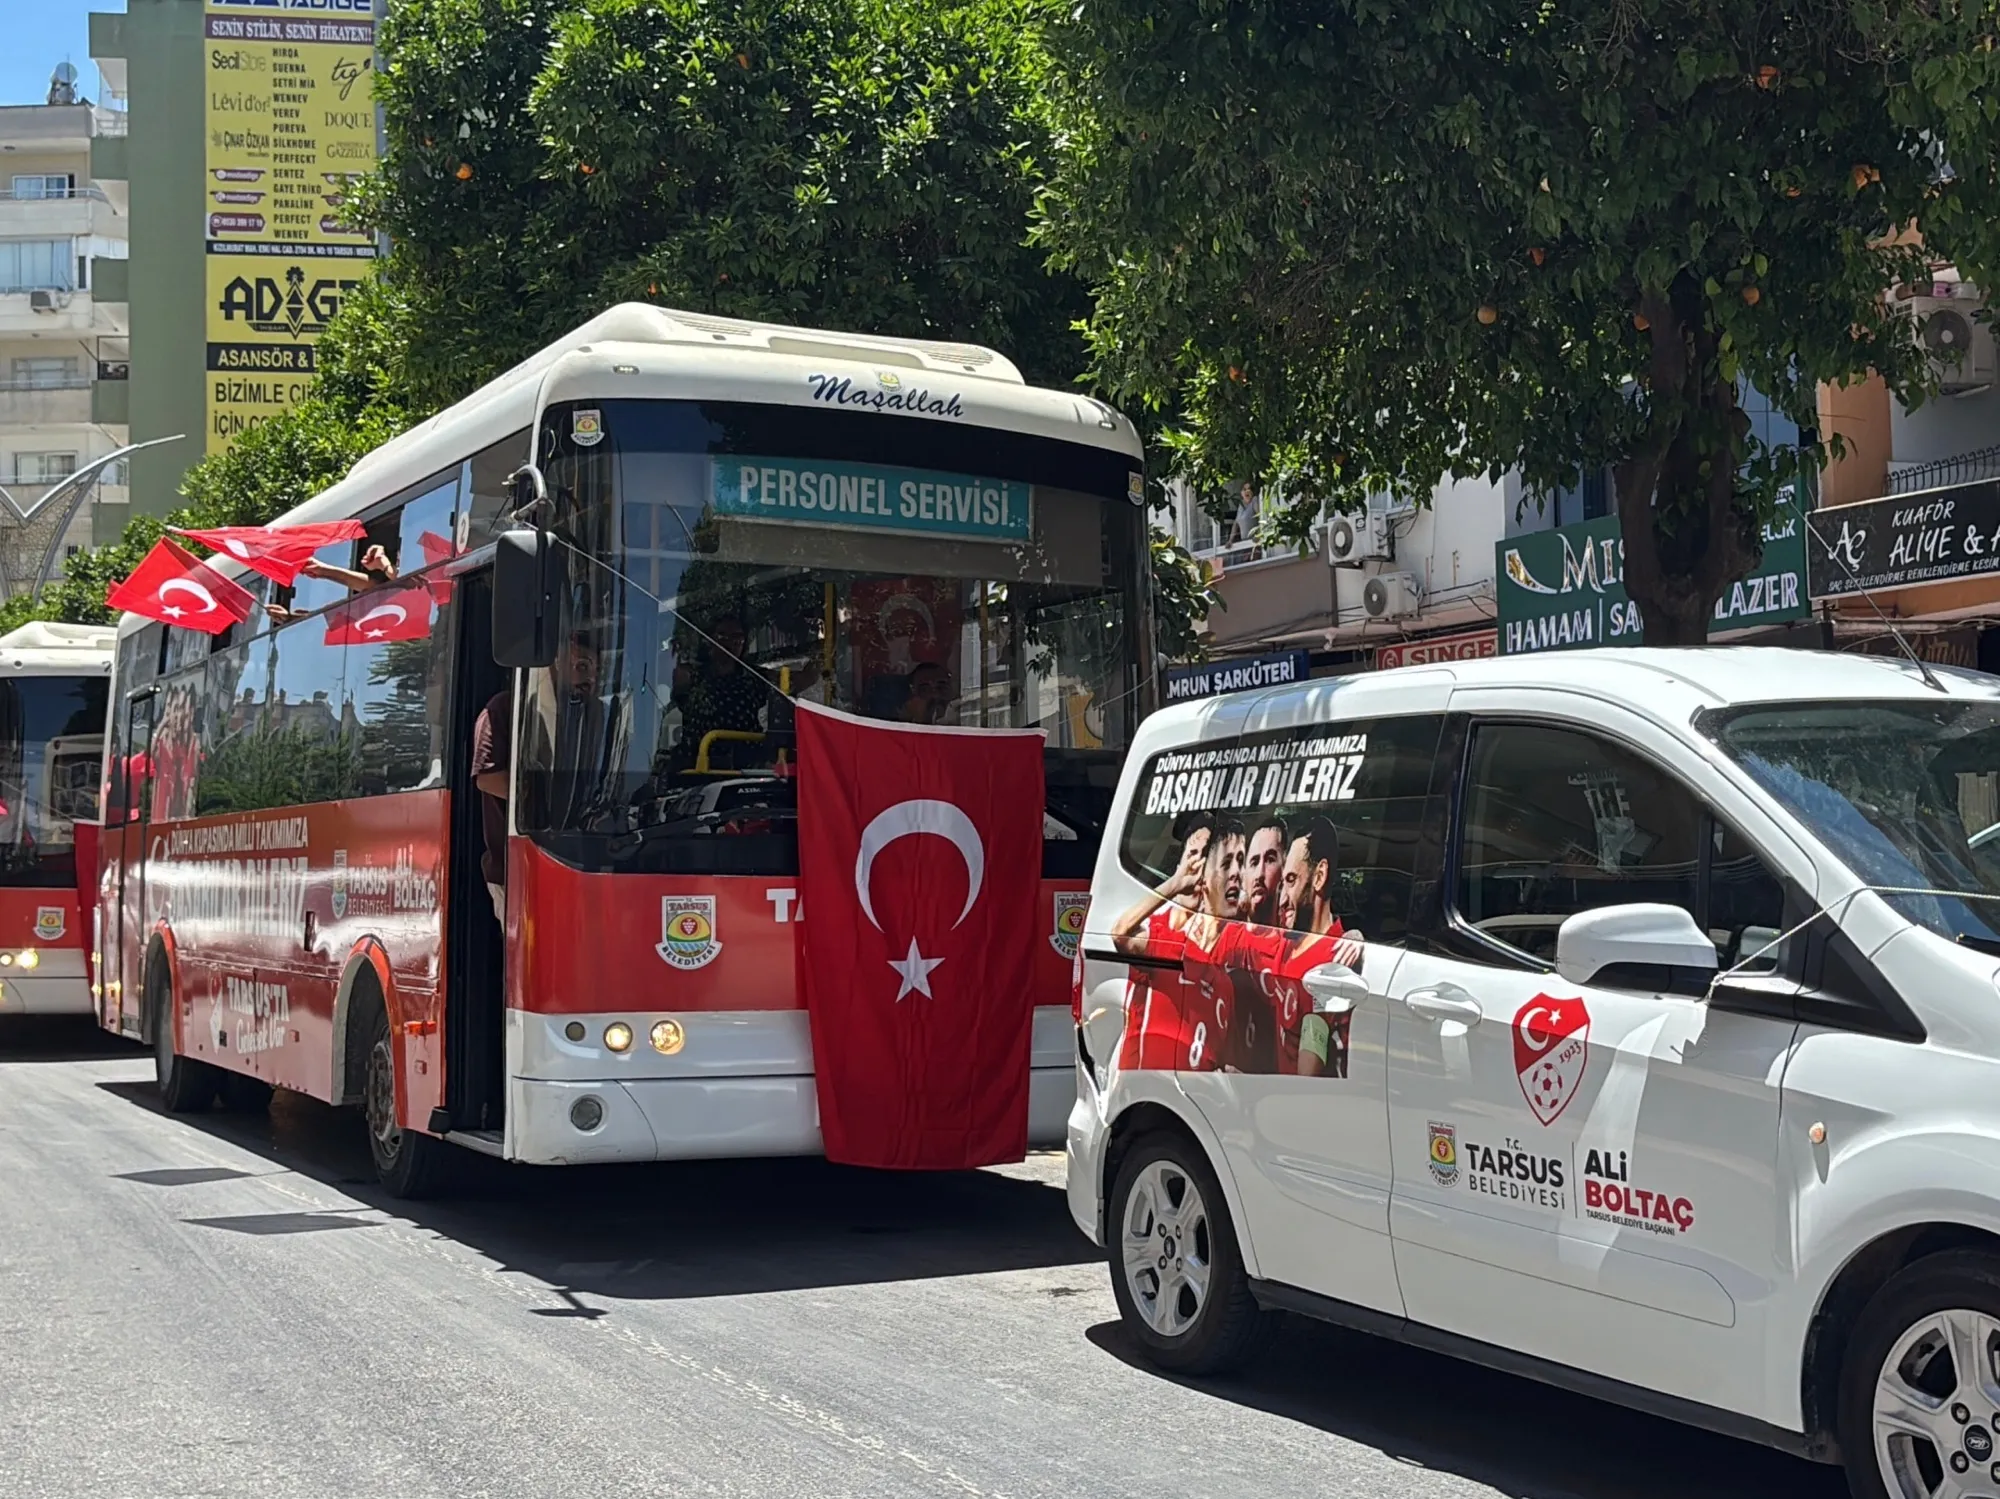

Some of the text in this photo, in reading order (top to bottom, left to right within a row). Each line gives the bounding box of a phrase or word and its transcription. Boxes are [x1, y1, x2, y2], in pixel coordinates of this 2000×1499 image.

[212, 18, 372, 42] SENİN STİLİN, SENİN HİKAYEN!!
[272, 123, 307, 133] PUREVA
[325, 111, 372, 129] DOQUE
[272, 153, 316, 164] PERFECKT
[272, 183, 295, 194] GAYE
[272, 214, 312, 224] PERFECT
[218, 347, 294, 367] ASANSÖR
[297, 351, 308, 367] &
[215, 378, 284, 403] BİZİMLE
[808, 373, 964, 417] Maşallah
[214, 410, 244, 439] İÇİN
[740, 466, 1010, 527] PERSONEL SERVİSİ
[1892, 499, 1955, 528] KUAFÖR
[1889, 524, 1955, 567] ALİYE
[1963, 524, 1984, 555] &
[1907, 564, 1970, 581] RENKLENDİRME
[1506, 608, 1593, 653] HAMAM
[1715, 572, 1799, 619] LAZER
[1213, 654, 1296, 697] ŞARKÜTERİ
[1155, 734, 1367, 774] DÜNYA KUPASINDA MİLLİ TAKIMIMIZA
[1145, 755, 1364, 818] BAŞARILAR DİLERİZ
[255, 816, 308, 851] TAKIMIMIZA
[348, 866, 388, 896] TARSUS
[394, 878, 436, 916] BOLTAÇ
[668, 902, 709, 911] TARSUS
[662, 944, 716, 966] BELEDİYESİ
[227, 976, 290, 1022] TARSUS'TA
[1559, 1041, 1581, 1064] 1923
[1505, 1137, 1523, 1151] T.C.
[1465, 1142, 1564, 1188] TARSUS
[1469, 1174, 1565, 1210] BELEDİYESİ
[1585, 1179, 1694, 1232] BOLTAÇ
[1586, 1209, 1675, 1236] TARSUS BELEDİYE BAŞKANI
